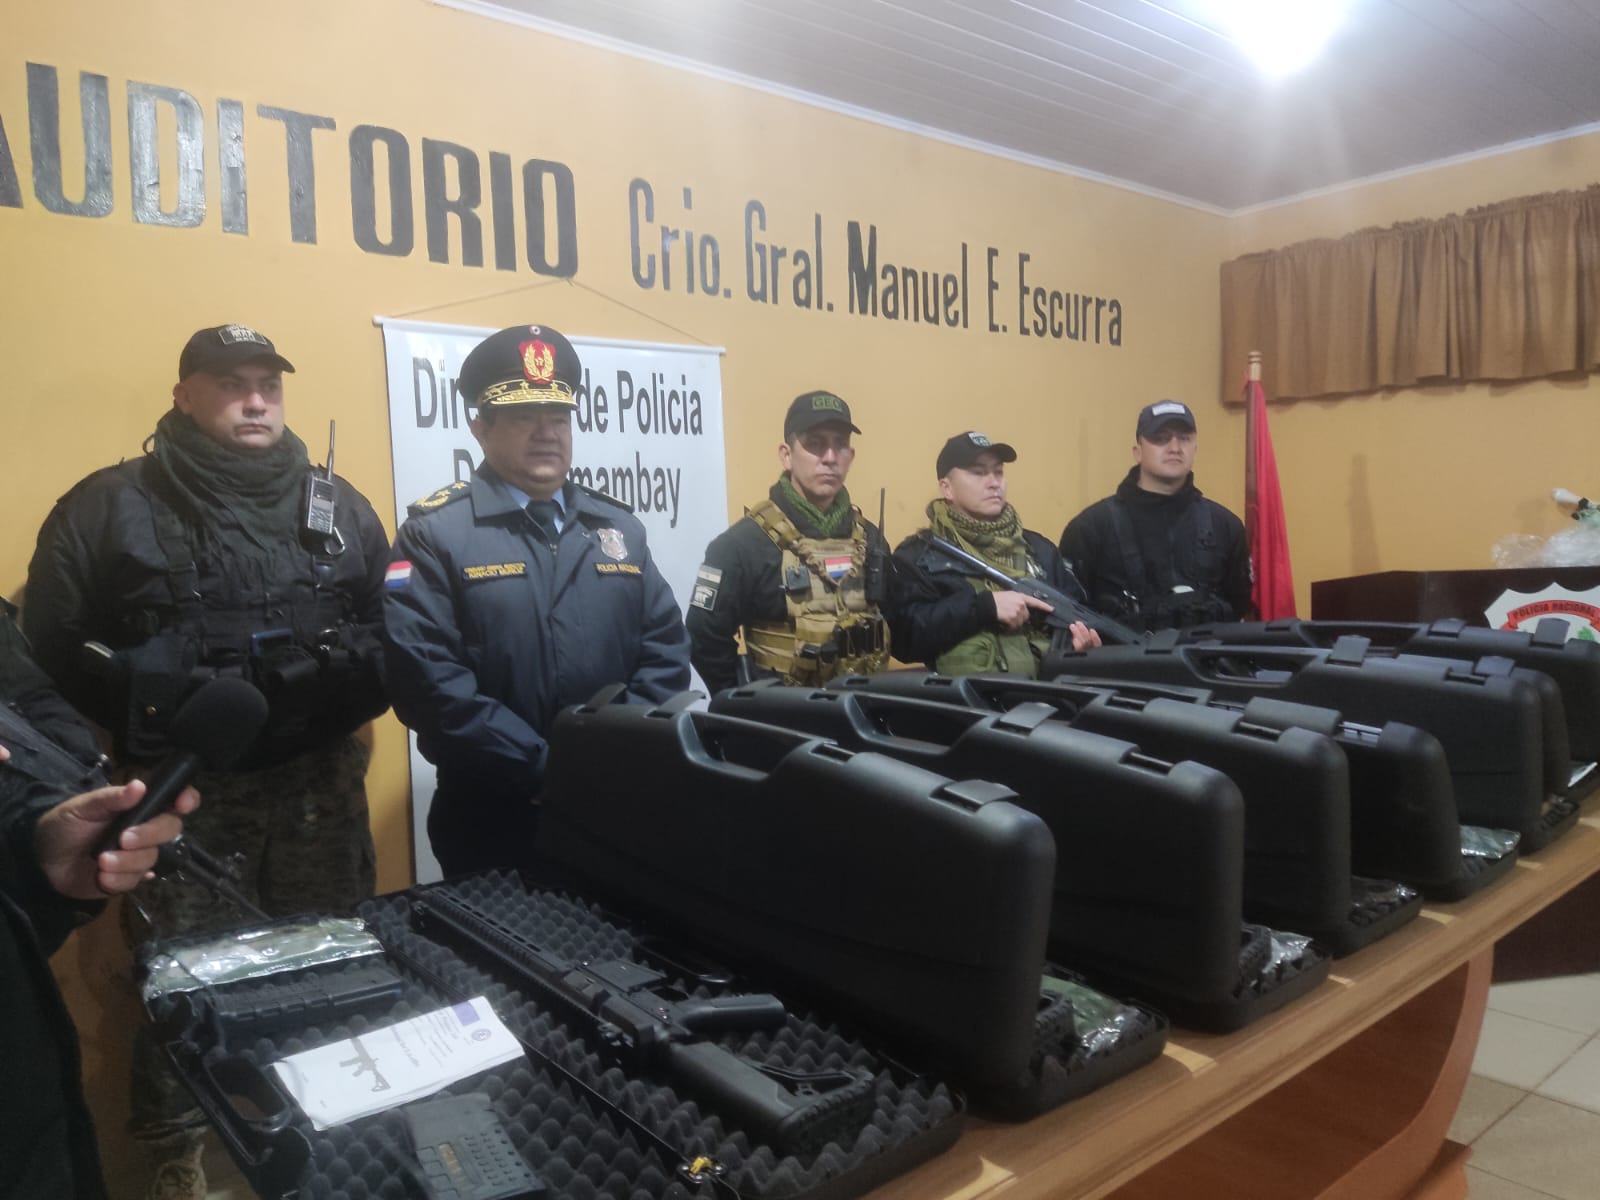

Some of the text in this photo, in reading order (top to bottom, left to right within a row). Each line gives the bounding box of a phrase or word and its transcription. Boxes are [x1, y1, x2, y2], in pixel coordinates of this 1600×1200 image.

[628, 177, 732, 298] Crio.
[744, 199, 834, 312] Gral.
[847, 220, 969, 329] Manuel
[988, 246, 1008, 333] E.
[1019, 252, 1122, 347] Escurra
[575, 367, 609, 434] de
[616, 369, 703, 437] Policia
[812, 397, 842, 411] GEO
